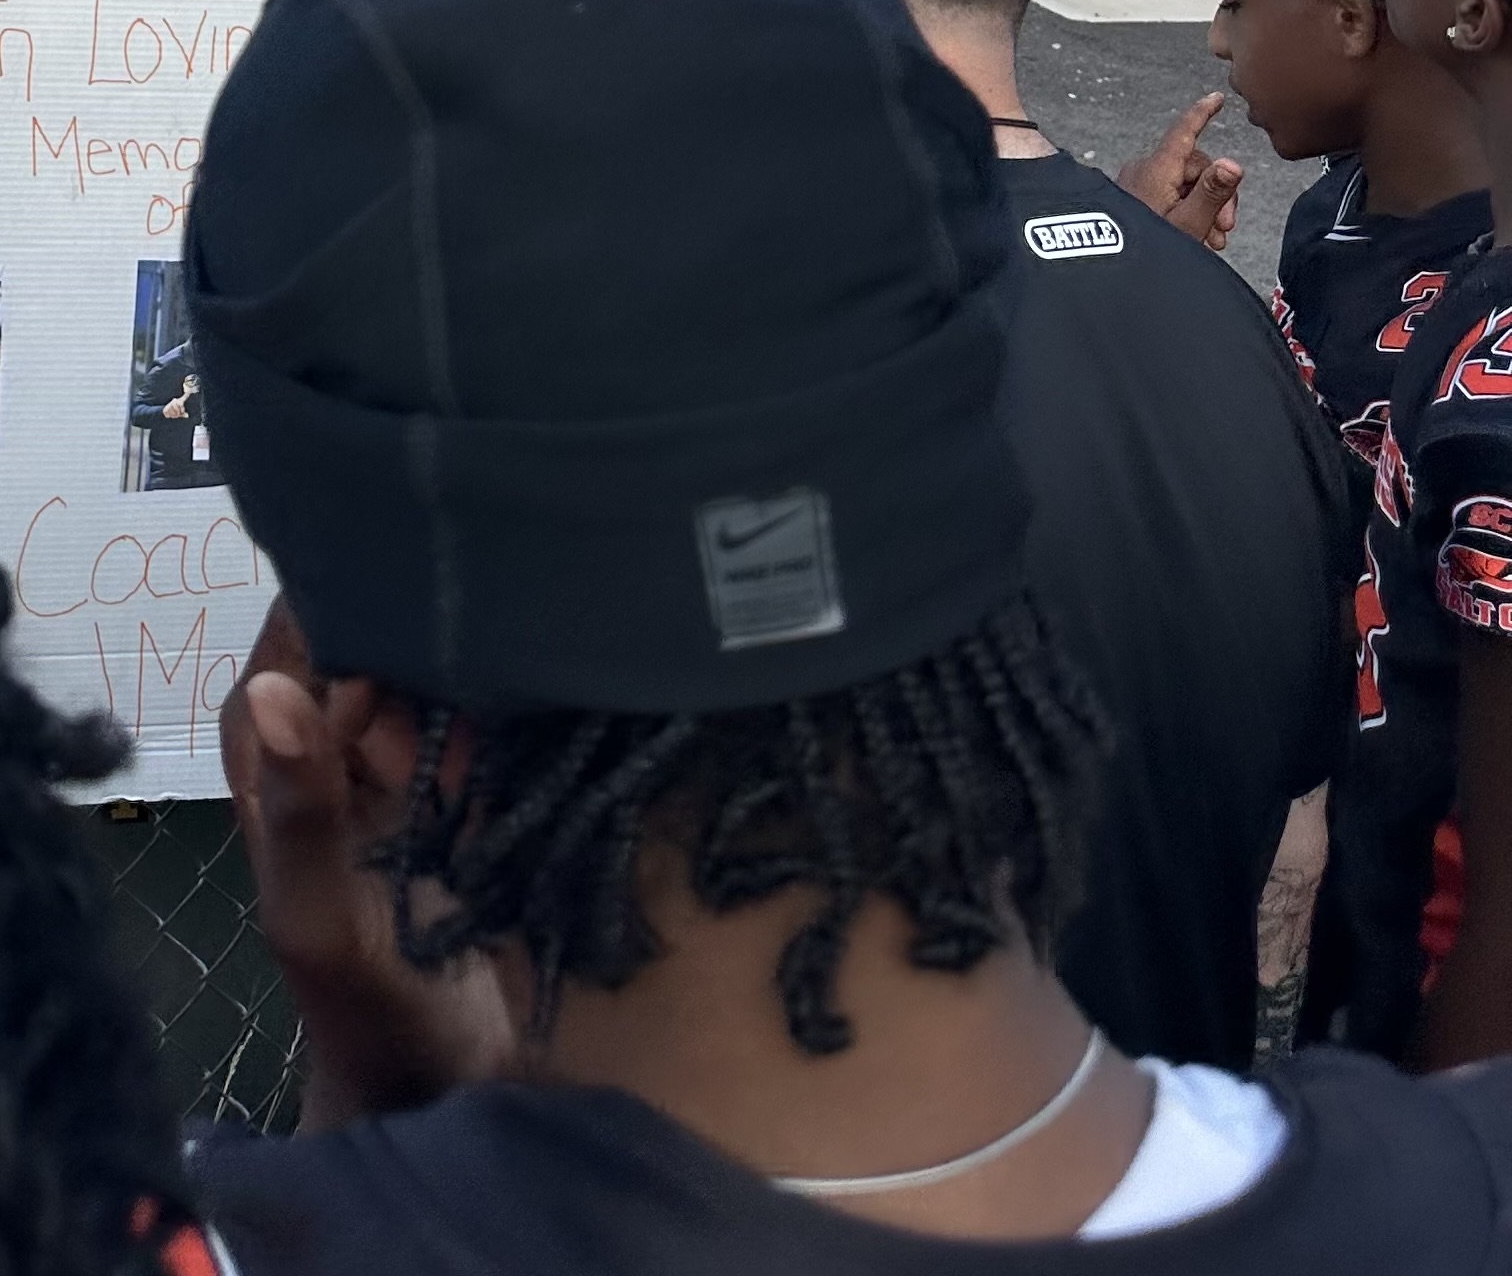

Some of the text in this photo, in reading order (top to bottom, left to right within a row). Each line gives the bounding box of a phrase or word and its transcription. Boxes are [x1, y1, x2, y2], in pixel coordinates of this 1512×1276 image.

[31, 115, 202, 195] Memo
[1033, 220, 1118, 251] BATTLE
[16, 496, 259, 617] Coac
